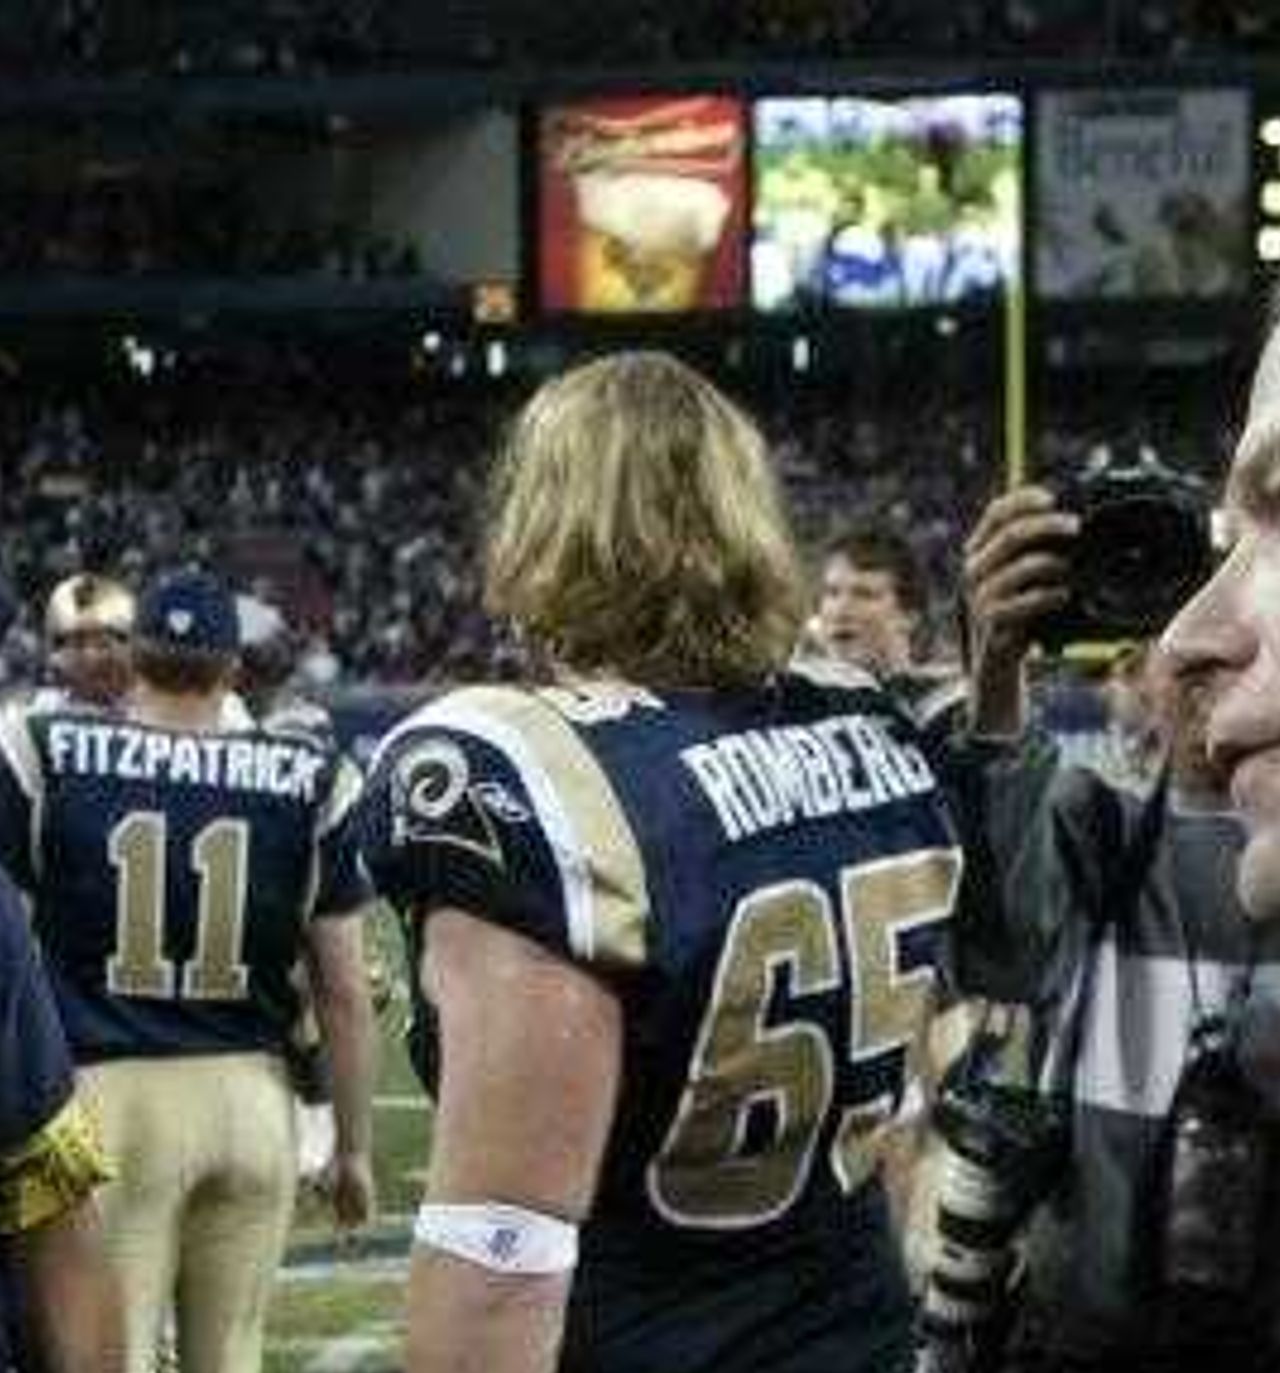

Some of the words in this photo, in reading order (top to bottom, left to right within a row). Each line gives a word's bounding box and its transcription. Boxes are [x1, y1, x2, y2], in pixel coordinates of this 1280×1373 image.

[49, 721, 325, 803] FITZPATRICK
[106, 810, 250, 999] 11
[646, 844, 964, 1230] 65
